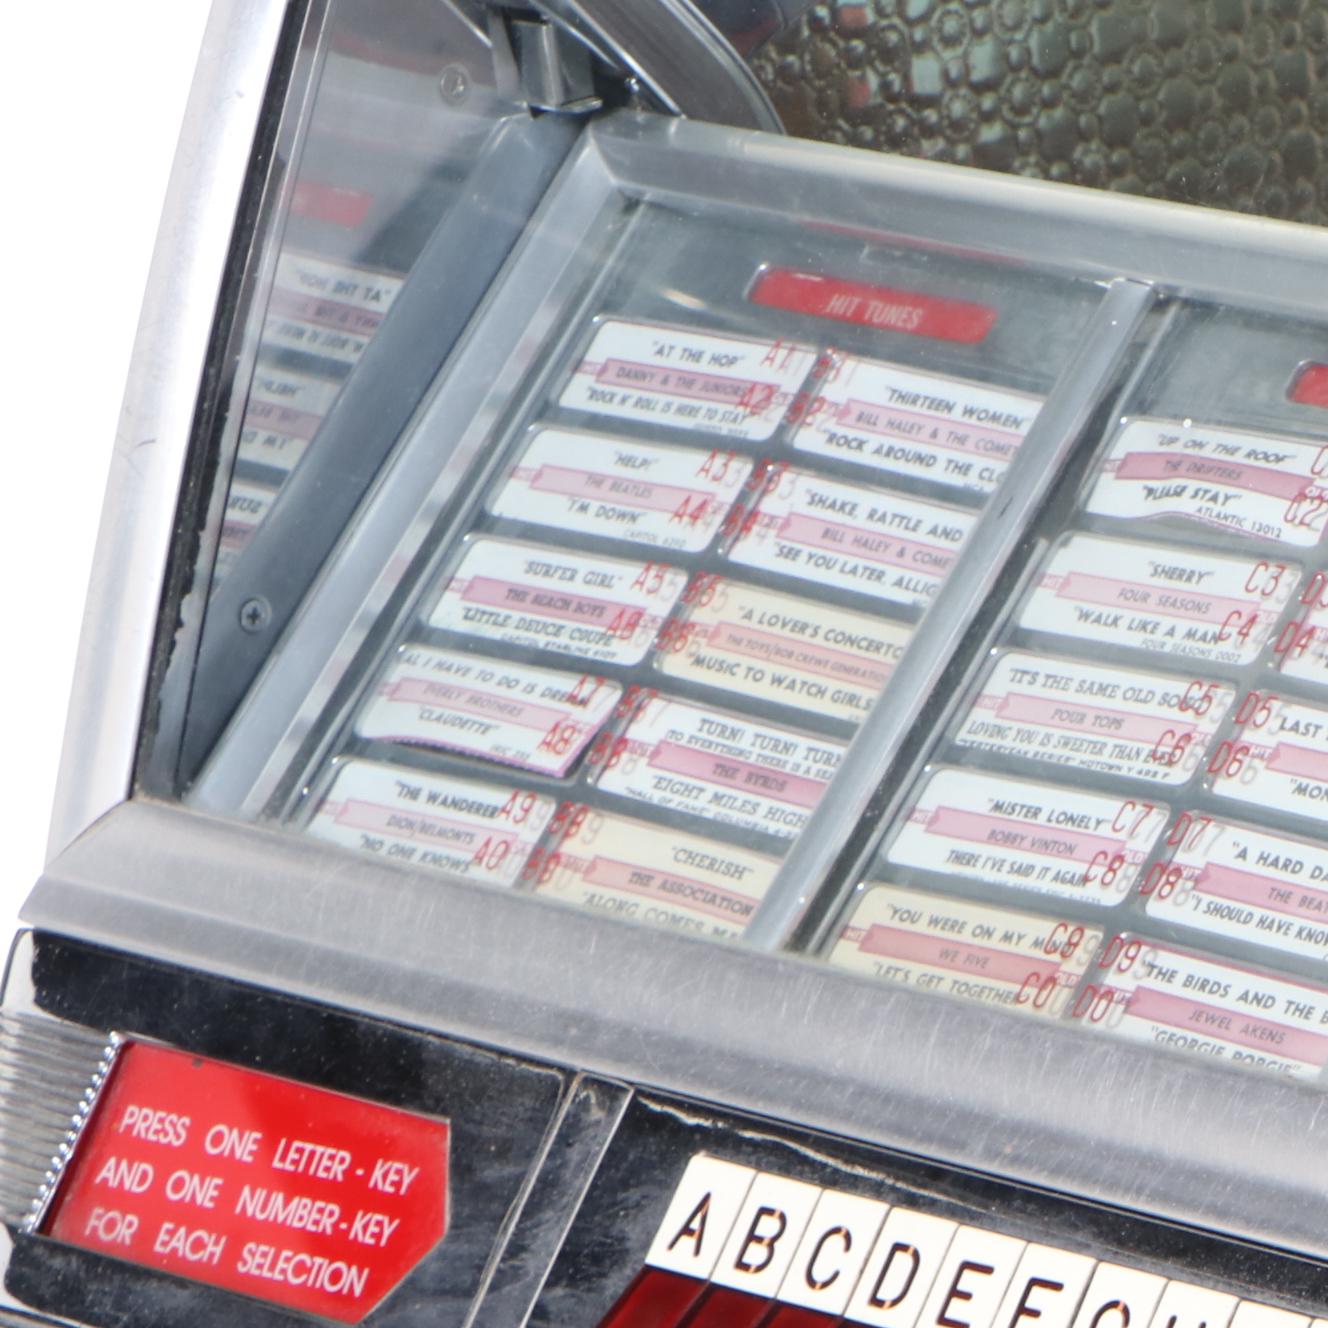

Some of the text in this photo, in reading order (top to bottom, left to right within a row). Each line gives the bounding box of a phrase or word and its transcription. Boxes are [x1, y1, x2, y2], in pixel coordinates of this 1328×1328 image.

[826, 294, 924, 330] HIT TUNES
[95, 1157, 153, 1193] AND
[166, 1170, 223, 1208] ONE
[119, 1106, 190, 1146] PRESS
[205, 1124, 262, 1162] ONE
[272, 1138, 351, 1181] LETTER
[369, 1159, 419, 1195] KEY
[85, 1207, 369, 1297] FOR EACH SELECTION
[667, 1191, 713, 1257] A
[734, 1205, 788, 1275] B
[805, 1225, 853, 1291] C
[867, 1241, 920, 1309] D
